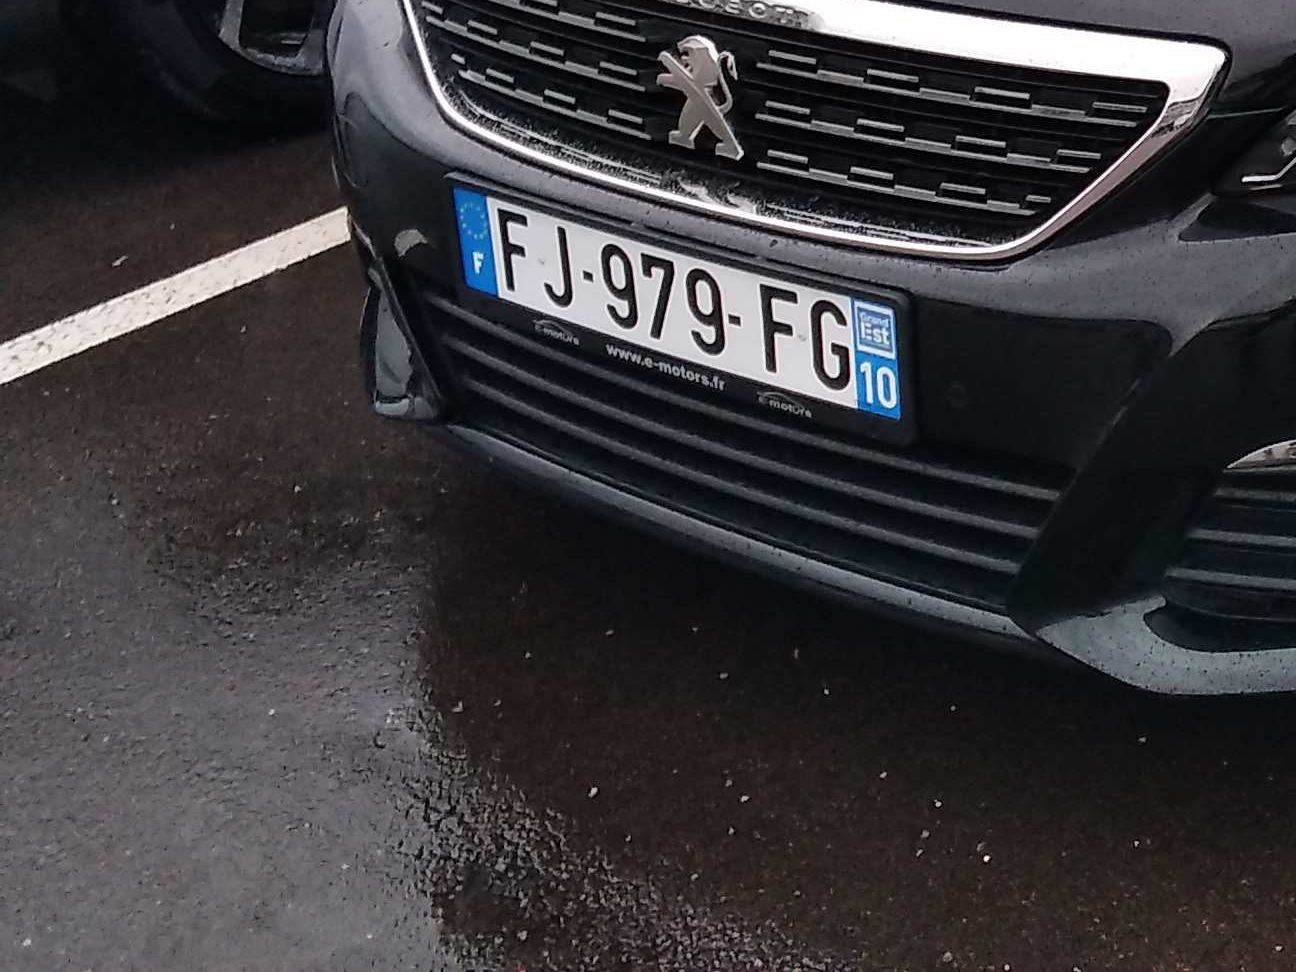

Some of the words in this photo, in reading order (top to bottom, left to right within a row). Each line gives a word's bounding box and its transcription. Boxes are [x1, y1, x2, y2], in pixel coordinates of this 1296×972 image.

[472, 251, 485, 275] F
[497, 208, 851, 391] FJ-979-FG
[860, 312, 889, 328] Grand
[861, 322, 889, 345] Est
[605, 344, 726, 391] www.e-motors.fr
[860, 362, 897, 409] 10
